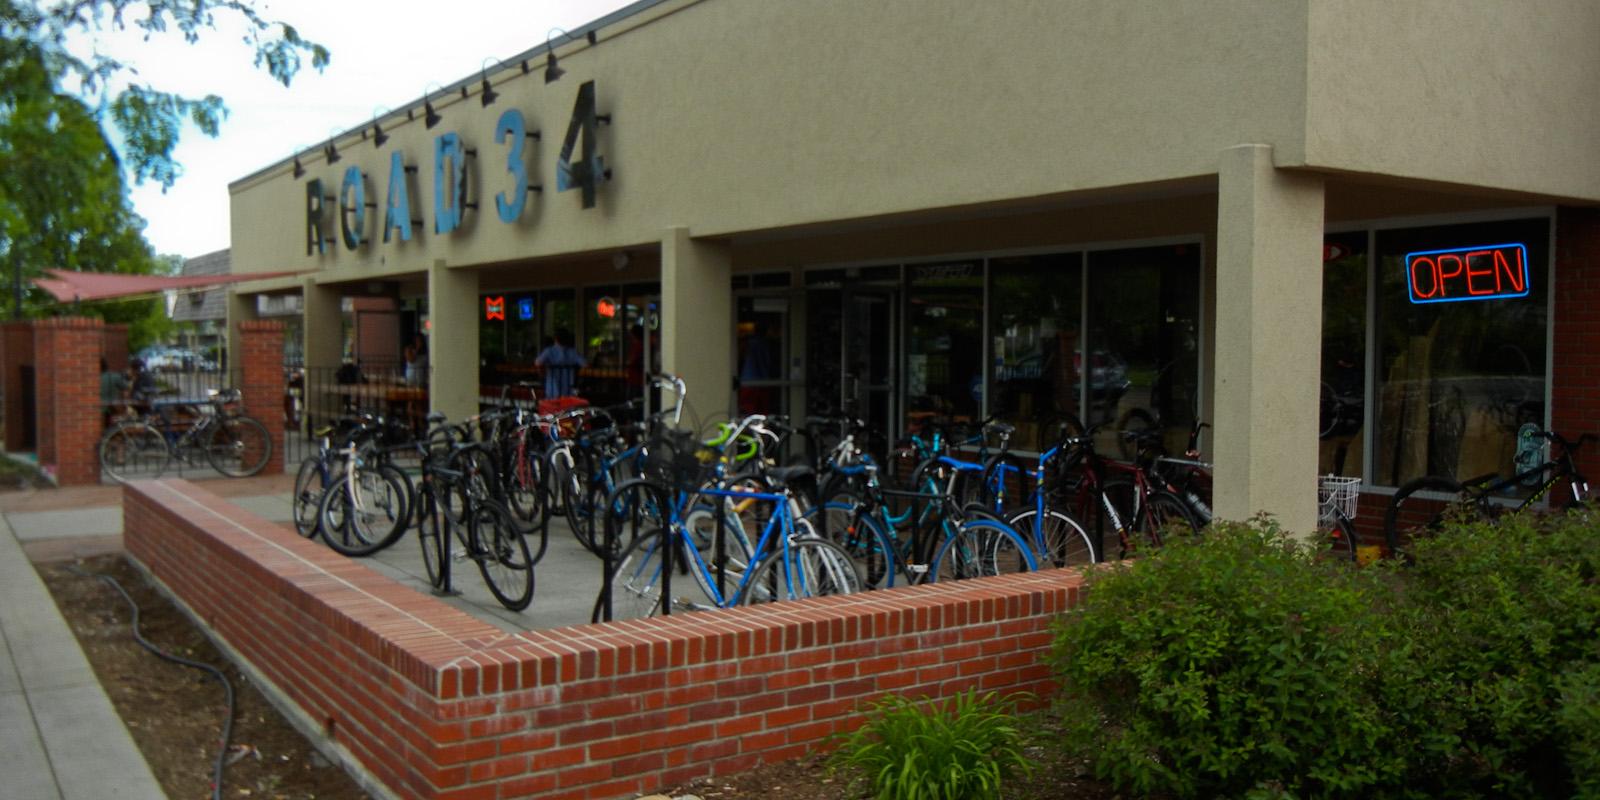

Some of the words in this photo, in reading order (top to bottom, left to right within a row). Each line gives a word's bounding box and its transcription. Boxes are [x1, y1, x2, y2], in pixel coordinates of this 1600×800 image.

[306, 132, 467, 257] ROAD
[495, 79, 603, 224] 34
[1411, 247, 1523, 298] OPEN
